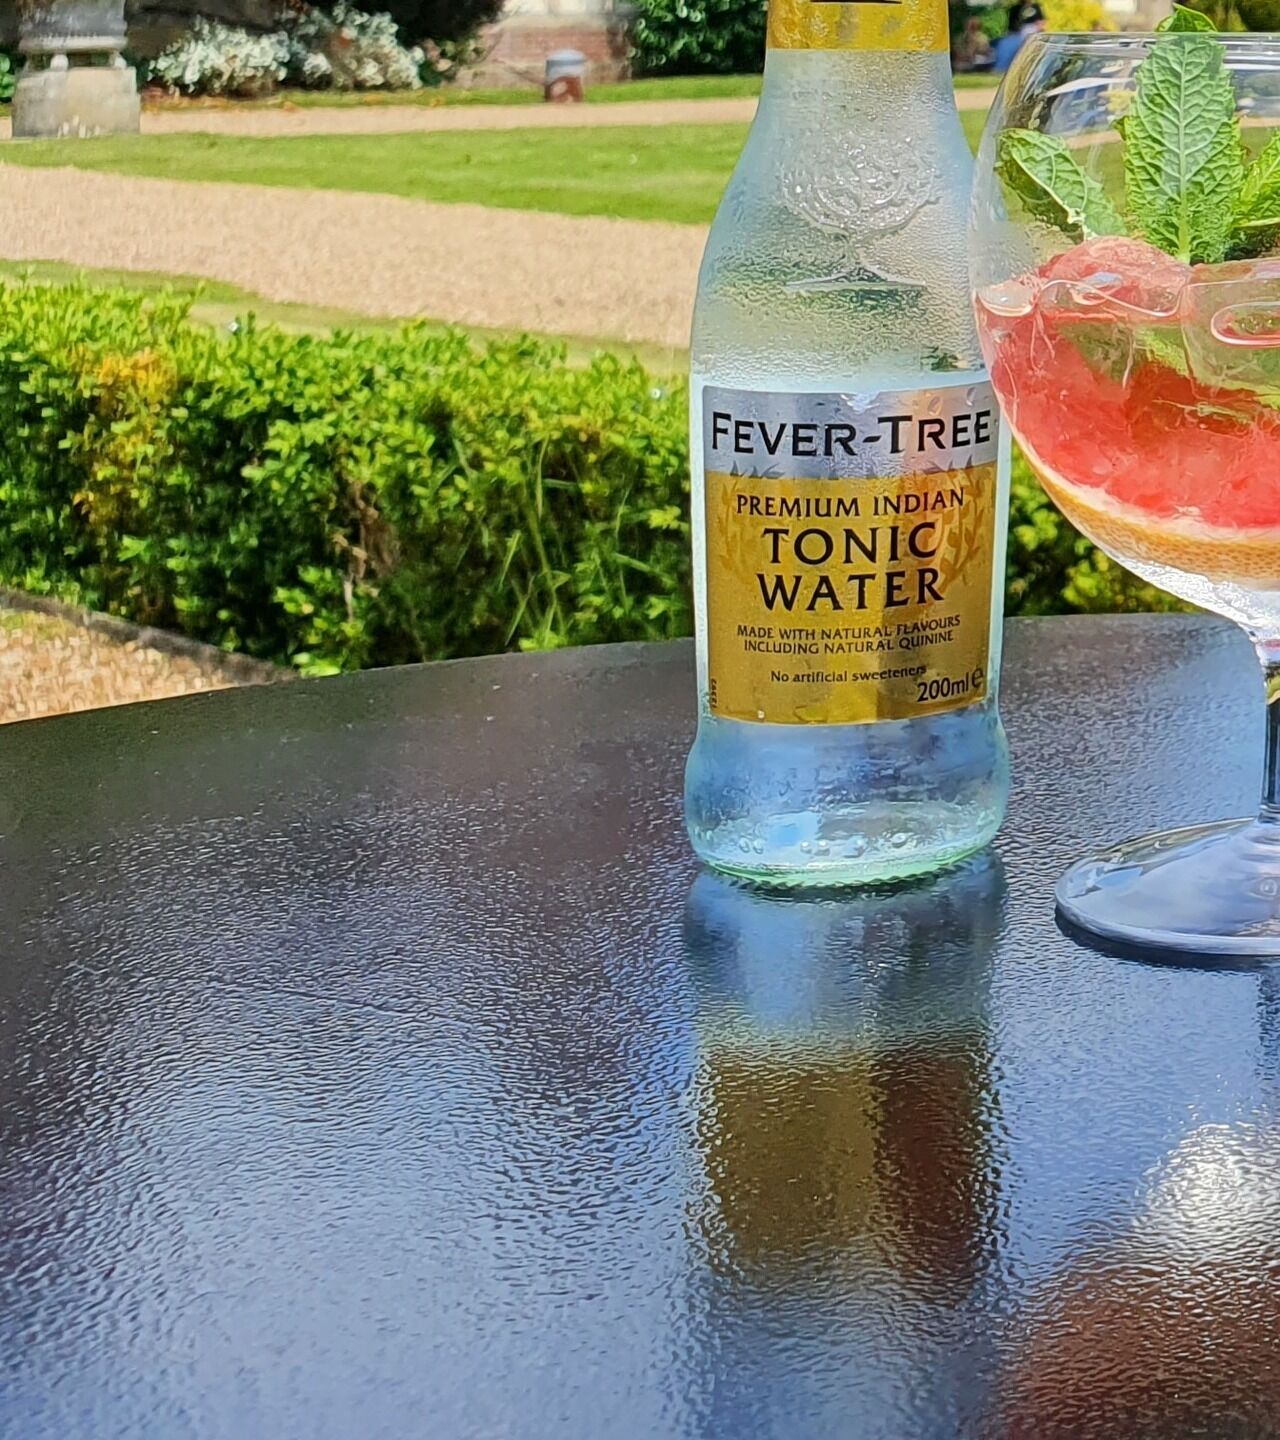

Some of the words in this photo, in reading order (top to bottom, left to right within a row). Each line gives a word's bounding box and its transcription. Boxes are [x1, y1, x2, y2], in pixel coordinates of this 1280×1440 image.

[712, 410, 991, 456] FEVER-TREE
[736, 494, 859, 518] PREMIUM
[873, 487, 964, 516] INDIAN
[762, 521, 938, 565] TONIC
[756, 568, 944, 611] WATER
[737, 625, 774, 639] MADE
[779, 628, 815, 640] WITH
[821, 625, 892, 640] NATURAL
[896, 614, 961, 635] FLAVOURS
[744, 640, 819, 654] INCLUDING
[824, 639, 894, 654] NATURAL
[899, 630, 953, 650] QUININE
[771, 671, 788, 682] No
[793, 670, 847, 682] artificial
[852, 664, 927, 681] sweeteners
[917, 672, 969, 702] 200ml
